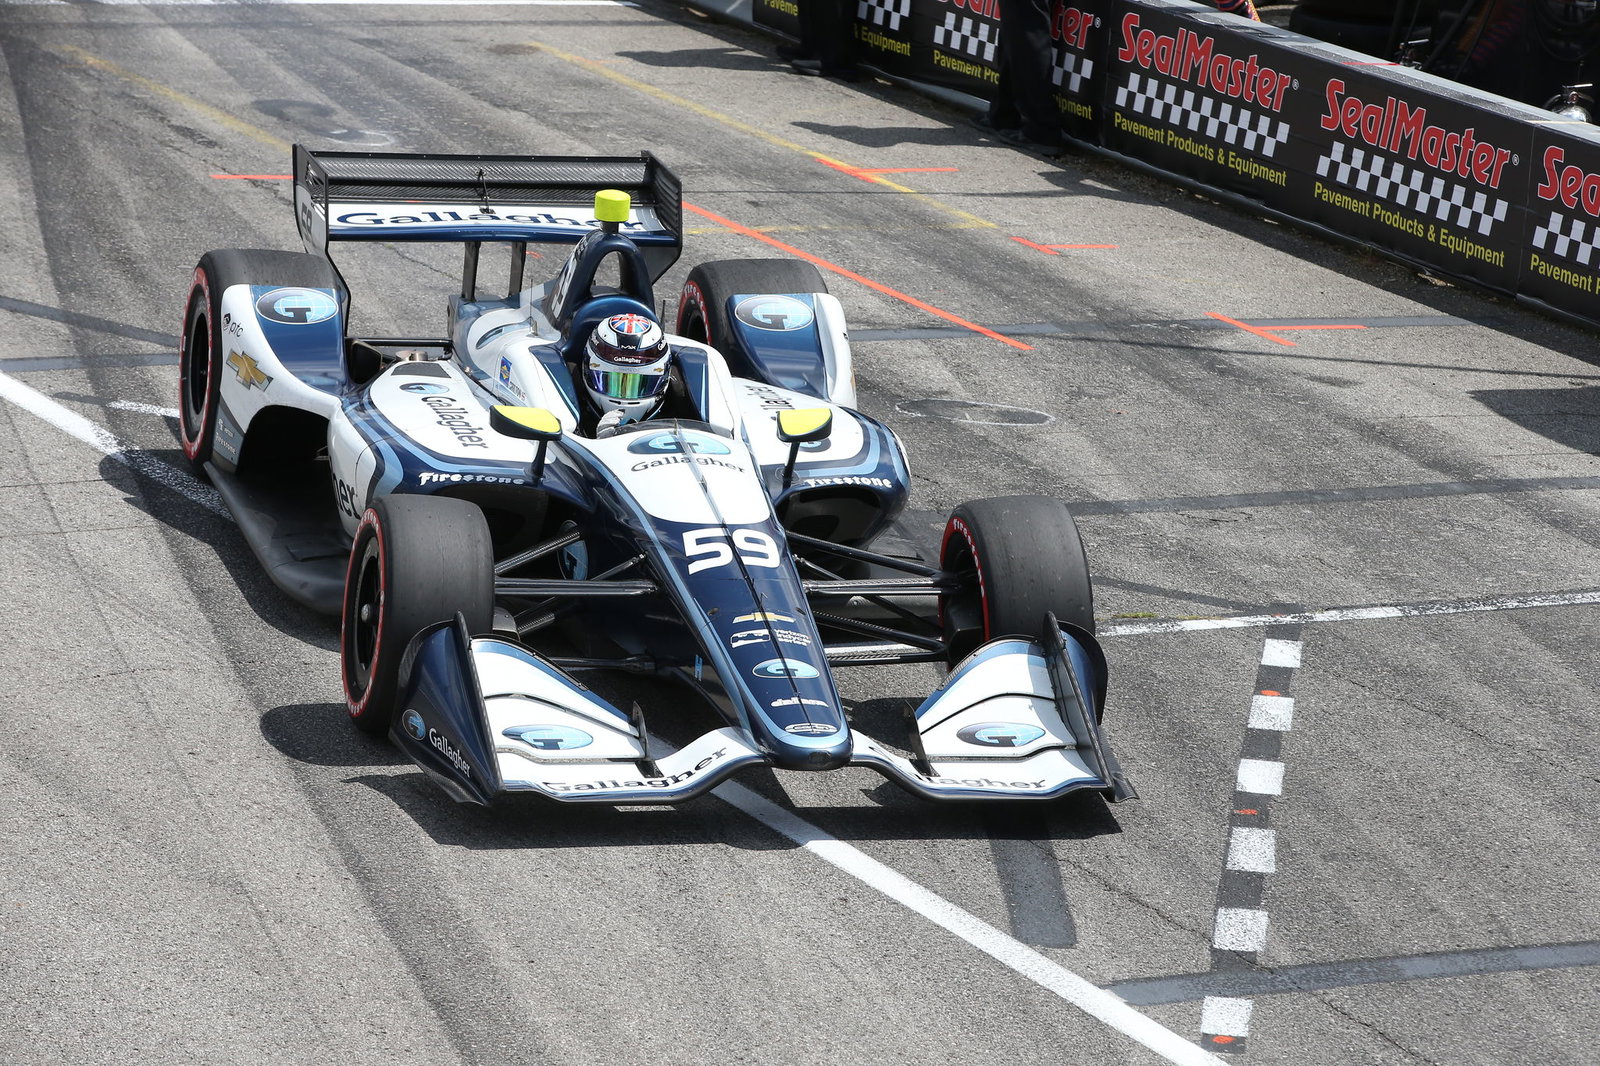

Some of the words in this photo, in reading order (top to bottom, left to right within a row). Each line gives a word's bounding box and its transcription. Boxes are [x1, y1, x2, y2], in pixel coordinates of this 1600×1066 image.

[861, 26, 911, 56] Equipment
[933, 50, 982, 79] Pavement
[1114, 112, 1165, 144] Pavement
[1167, 130, 1214, 161] Products
[1217, 150, 1226, 166] &
[1228, 152, 1287, 187] Equipment
[1314, 181, 1370, 217] Pavement
[1373, 202, 1424, 238] Products
[1427, 226, 1436, 243] &
[1439, 228, 1505, 268] Equipment
[1530, 253, 1592, 292] Pavement
[421, 396, 489, 449] Gallagher
[418, 472, 525, 486] Firestone
[631, 455, 746, 473] Gallagher
[803, 476, 893, 489] Firestone
[682, 526, 781, 576] 59
[429, 727, 470, 778] Gallagher
